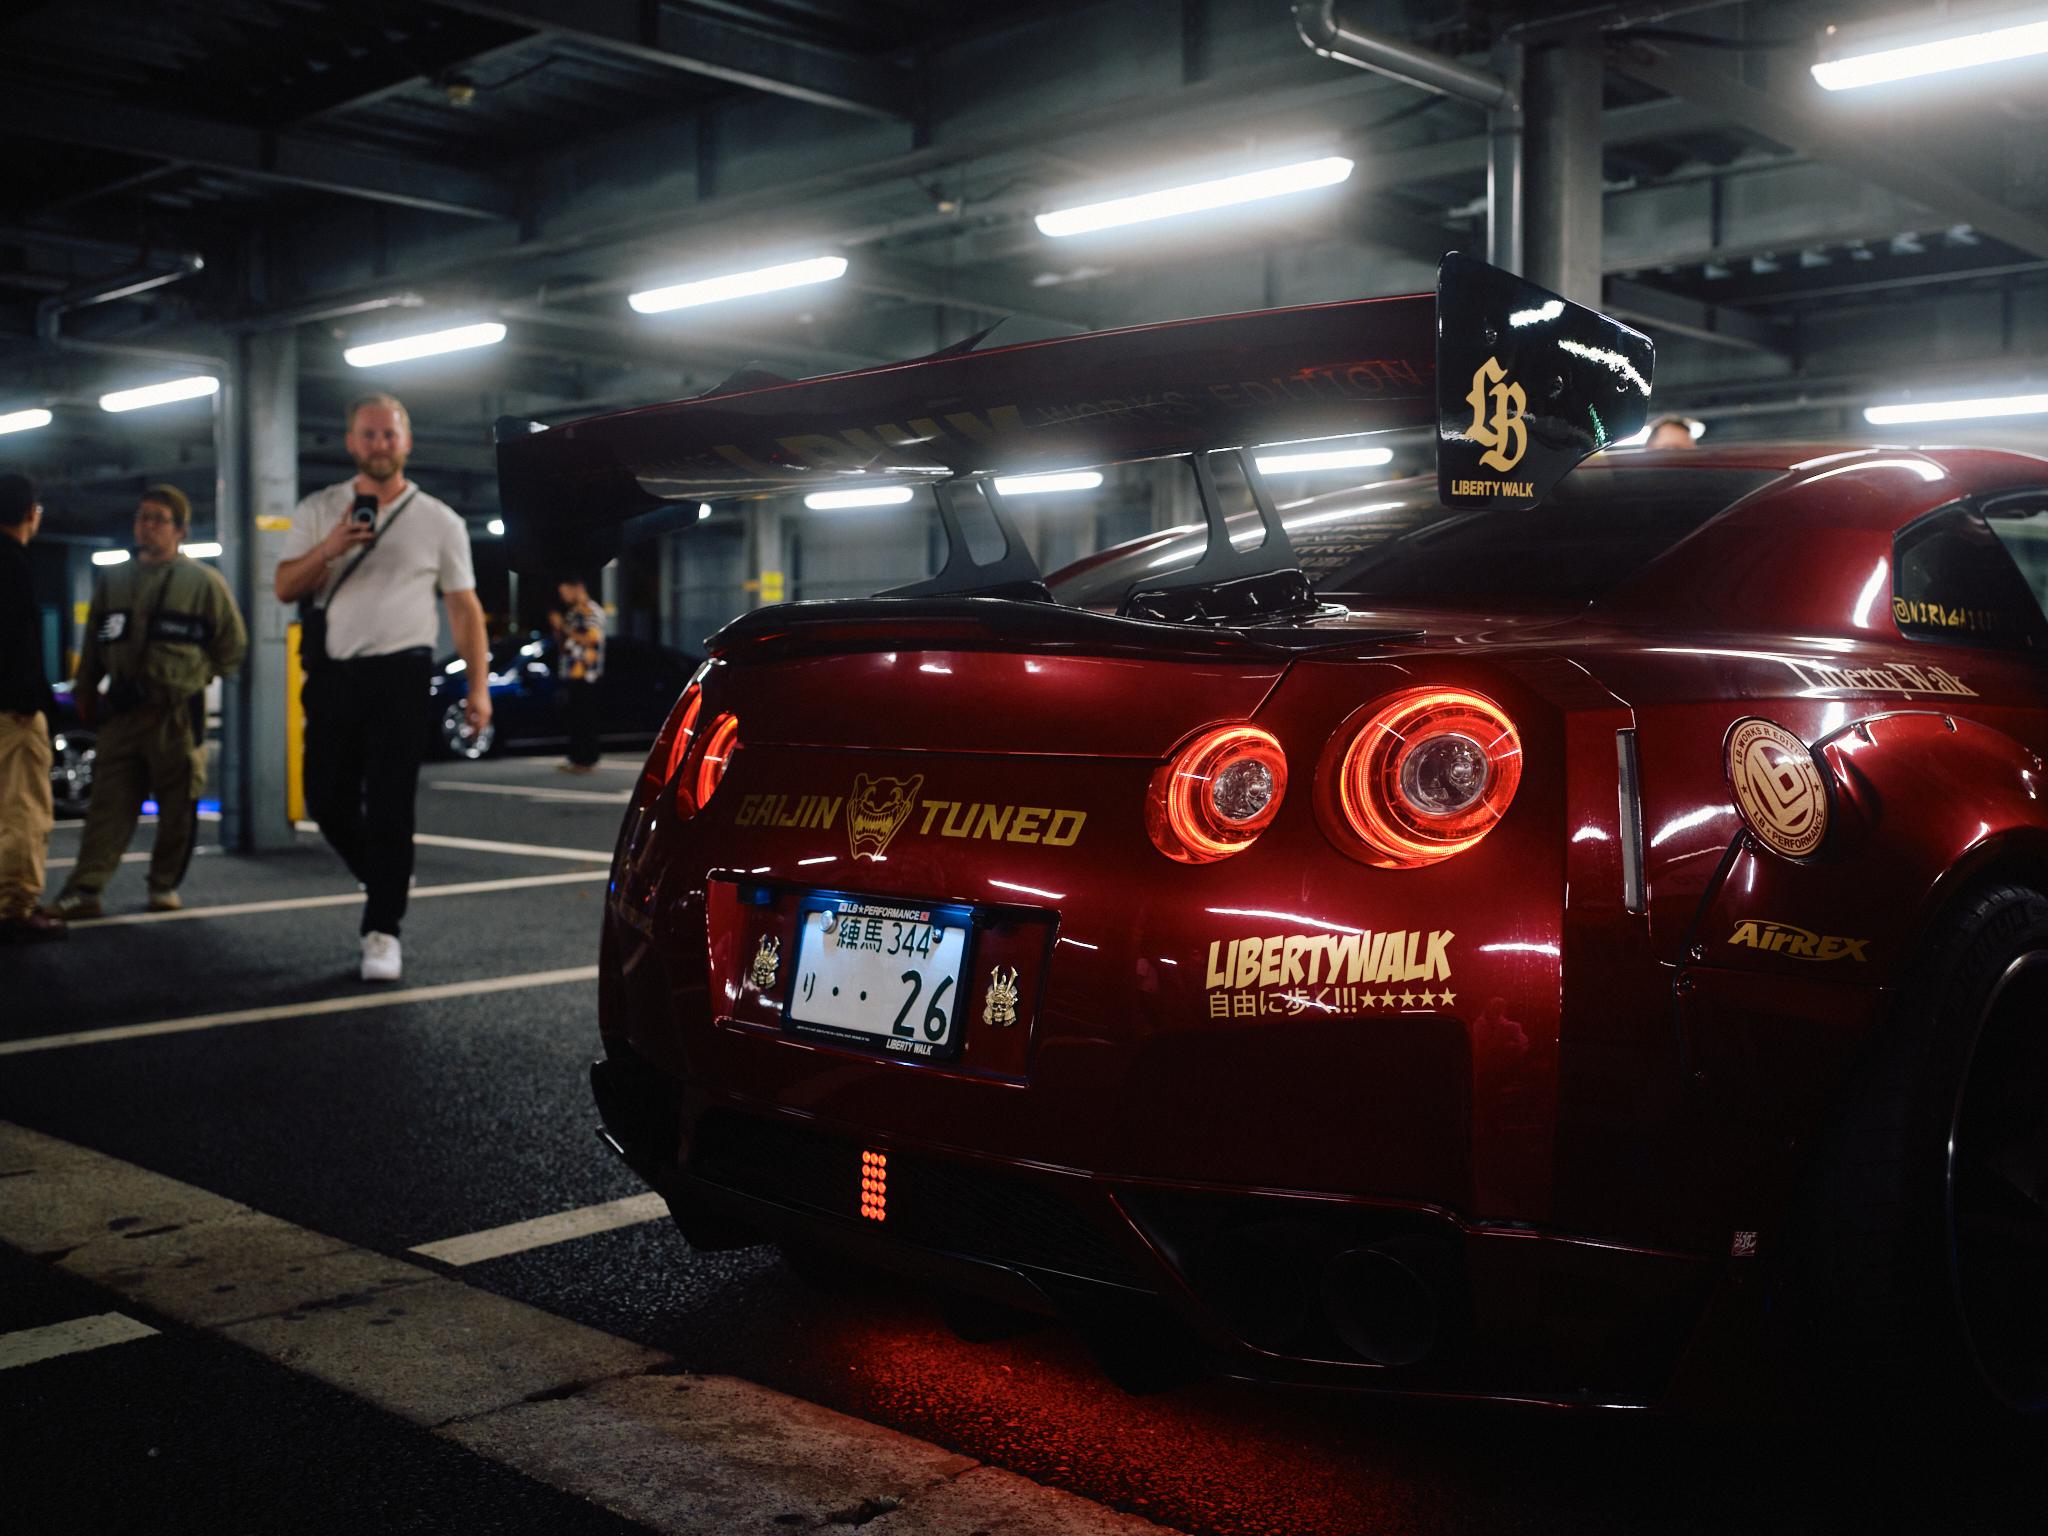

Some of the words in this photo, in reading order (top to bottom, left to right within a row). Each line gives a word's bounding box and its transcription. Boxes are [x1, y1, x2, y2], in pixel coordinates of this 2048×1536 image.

[1208, 359, 1425, 409] EDITION
[1452, 479, 1500, 496] LIBERTY
[1502, 481, 1534, 497] WALK
[1883, 662, 1980, 697] Walk
[734, 794, 843, 829] GAIJIN
[920, 800, 1088, 847] TUNED
[1753, 811, 1766, 829] LB
[1771, 808, 1823, 849] PERFORMANCE
[837, 917, 883, 952] 練馬
[887, 922, 932, 959] 344
[892, 970, 955, 1042] 26
[885, 1038, 913, 1052] LIBERTY
[913, 1043, 933, 1056] WALK
